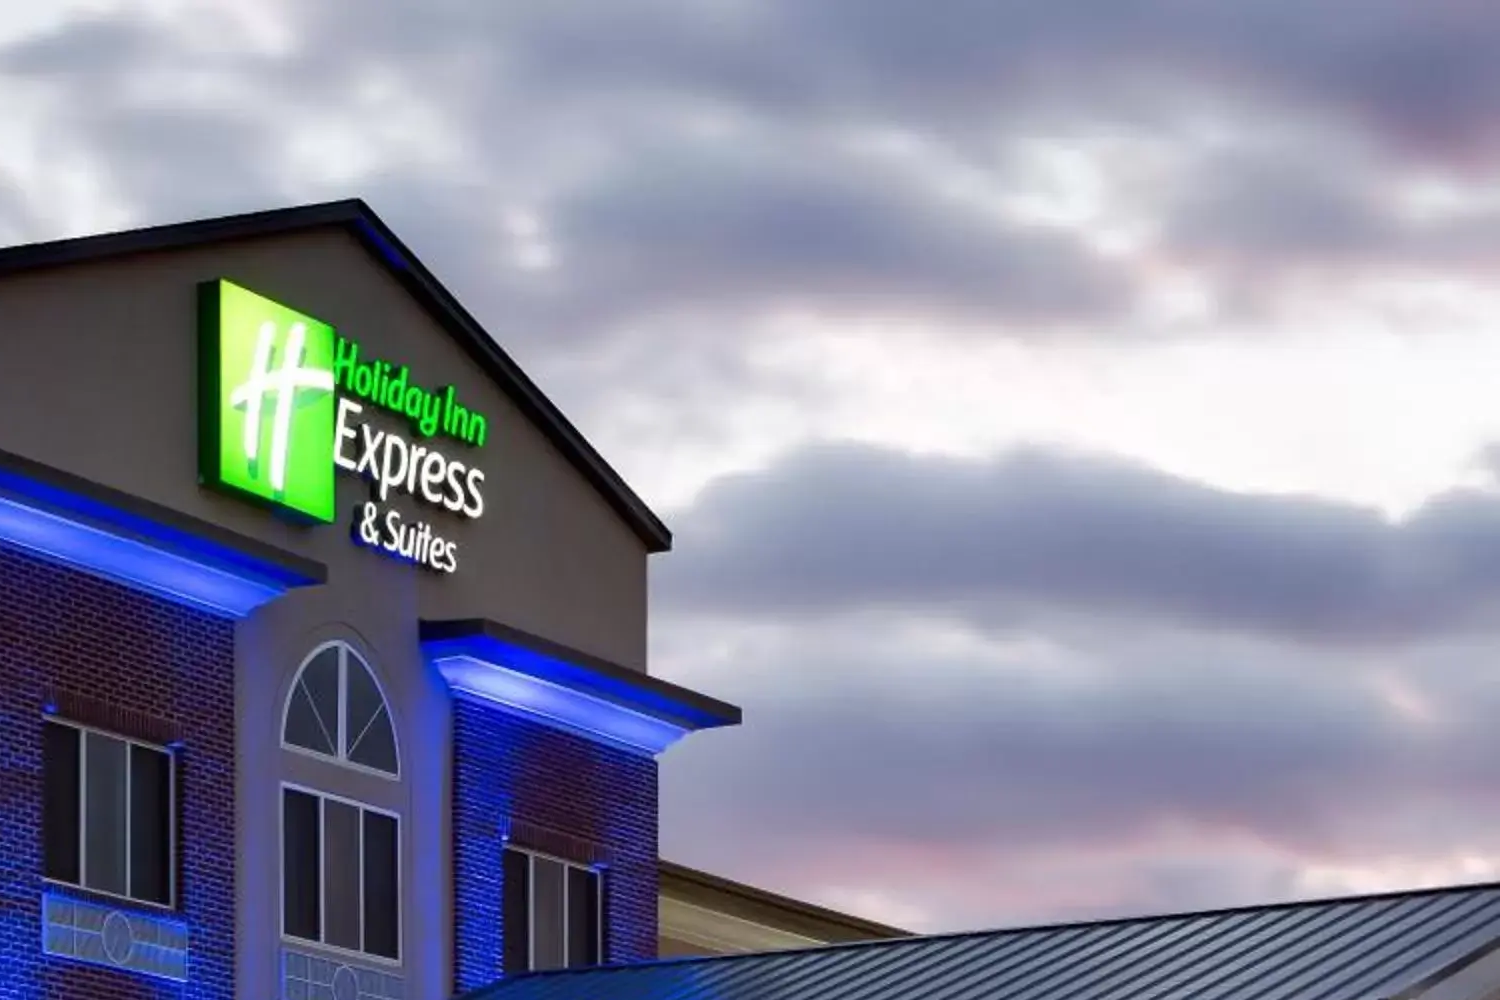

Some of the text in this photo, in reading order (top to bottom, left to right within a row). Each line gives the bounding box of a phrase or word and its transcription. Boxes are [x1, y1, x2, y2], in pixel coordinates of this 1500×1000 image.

[334, 337, 486, 447] Holiday Inn
[333, 397, 485, 518] Express
[360, 502, 457, 573] & Suites
